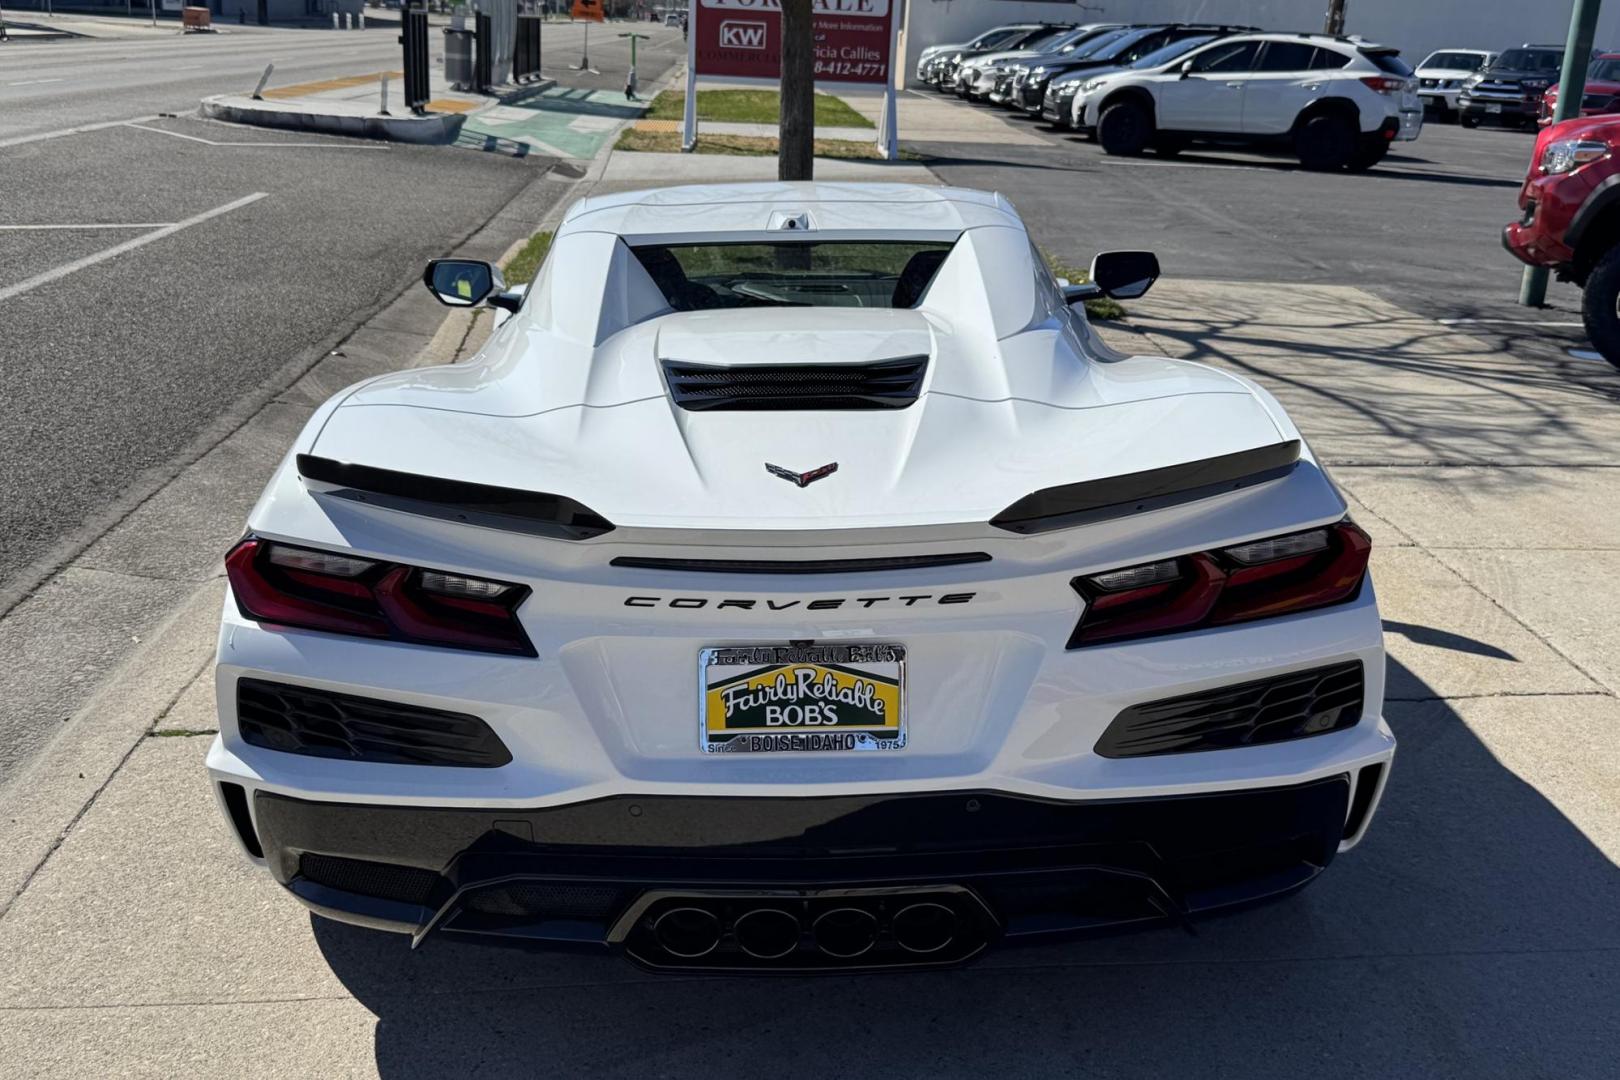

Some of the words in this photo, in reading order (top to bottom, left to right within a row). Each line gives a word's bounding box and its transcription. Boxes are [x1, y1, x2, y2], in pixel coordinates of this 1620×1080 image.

[723, 27, 764, 46] KW
[841, 46, 881, 61] Callies
[814, 60, 886, 76] 8-412-4771
[624, 592, 977, 610] CORVETTE
[721, 674, 798, 718] Fairly
[794, 667, 886, 715] Reliable
[766, 700, 839, 726] BOB'S
[751, 735, 800, 751] BOISE
[806, 733, 855, 750] IDAHO
[875, 740, 900, 750] 1975
